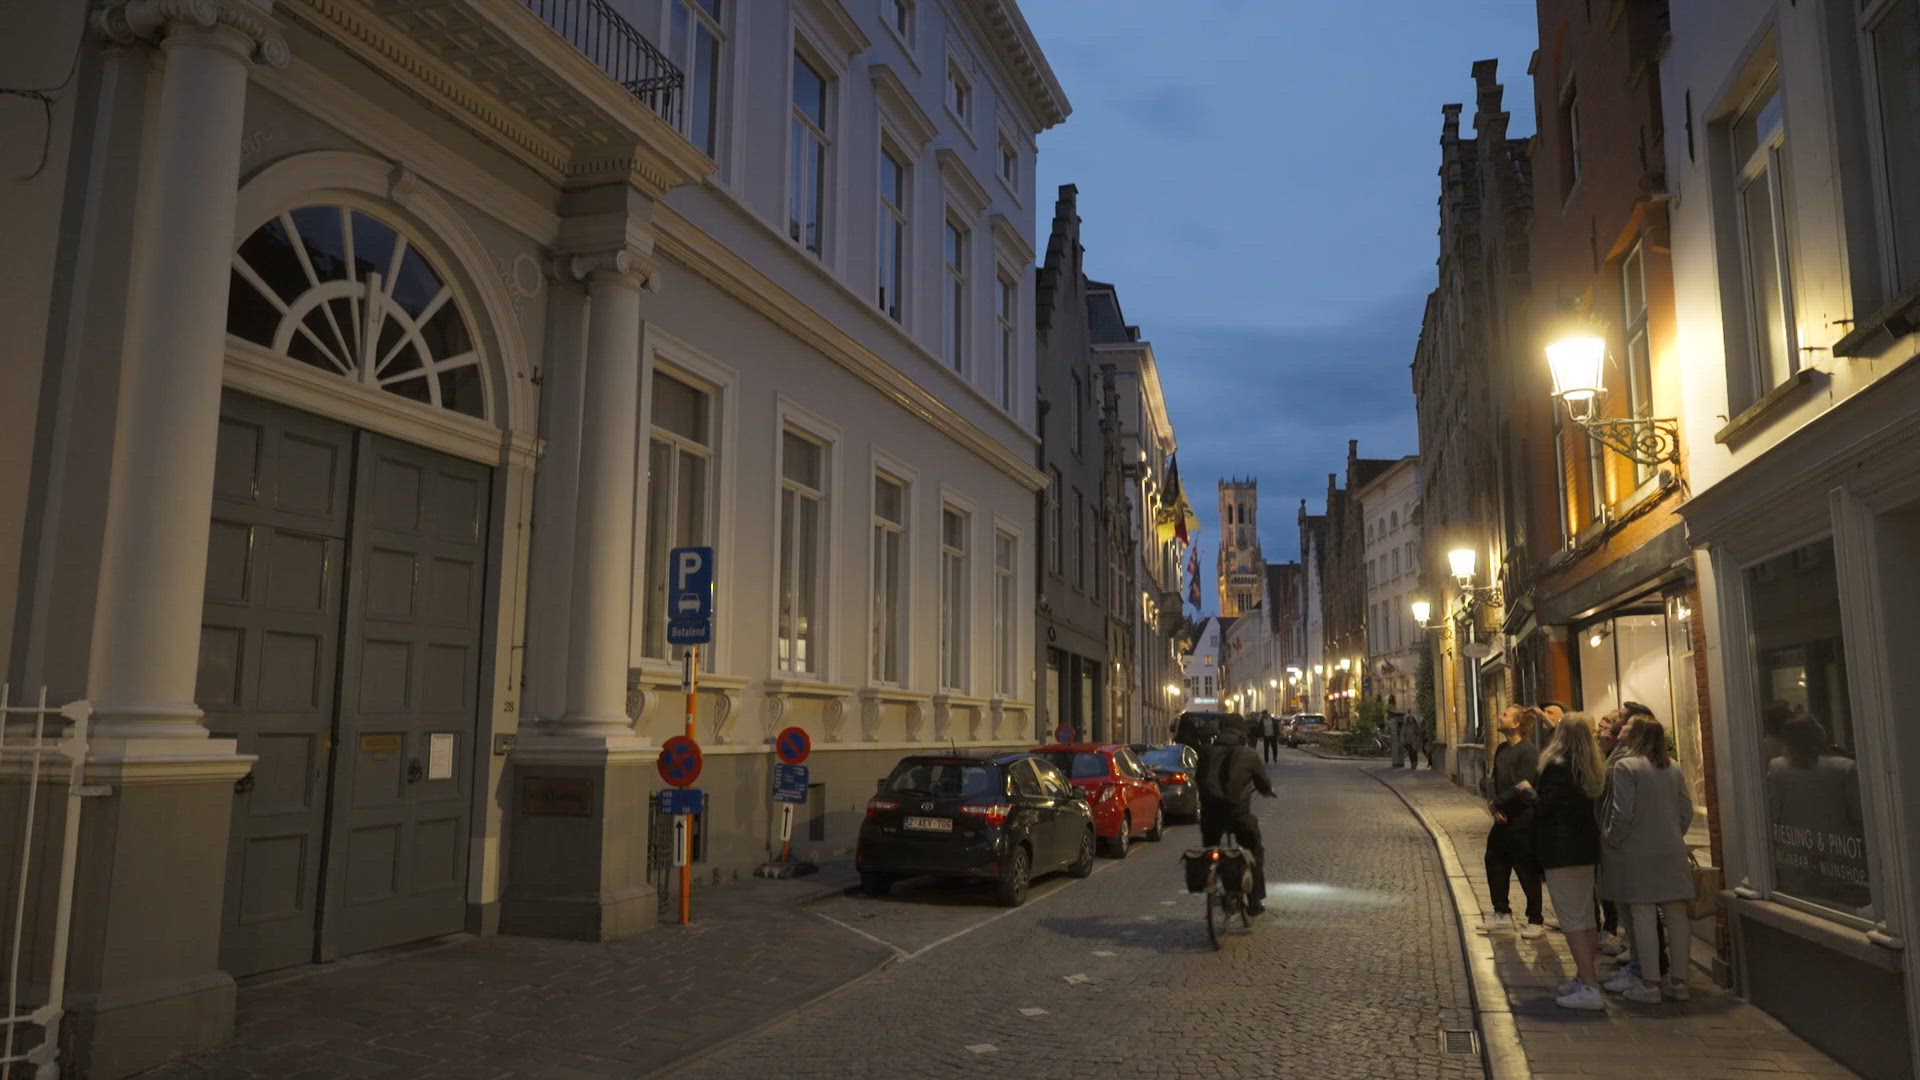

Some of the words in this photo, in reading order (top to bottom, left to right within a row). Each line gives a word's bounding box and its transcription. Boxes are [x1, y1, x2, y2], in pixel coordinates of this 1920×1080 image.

[678, 552, 702, 590] P
[671, 627, 706, 637] Betalend
[504, 701, 514, 712] 28
[1773, 824, 1813, 849] RIESLING
[1817, 832, 1825, 852] &
[1829, 833, 1863, 859] PINOT
[1819, 861, 1866, 883] WIJNSHOP
